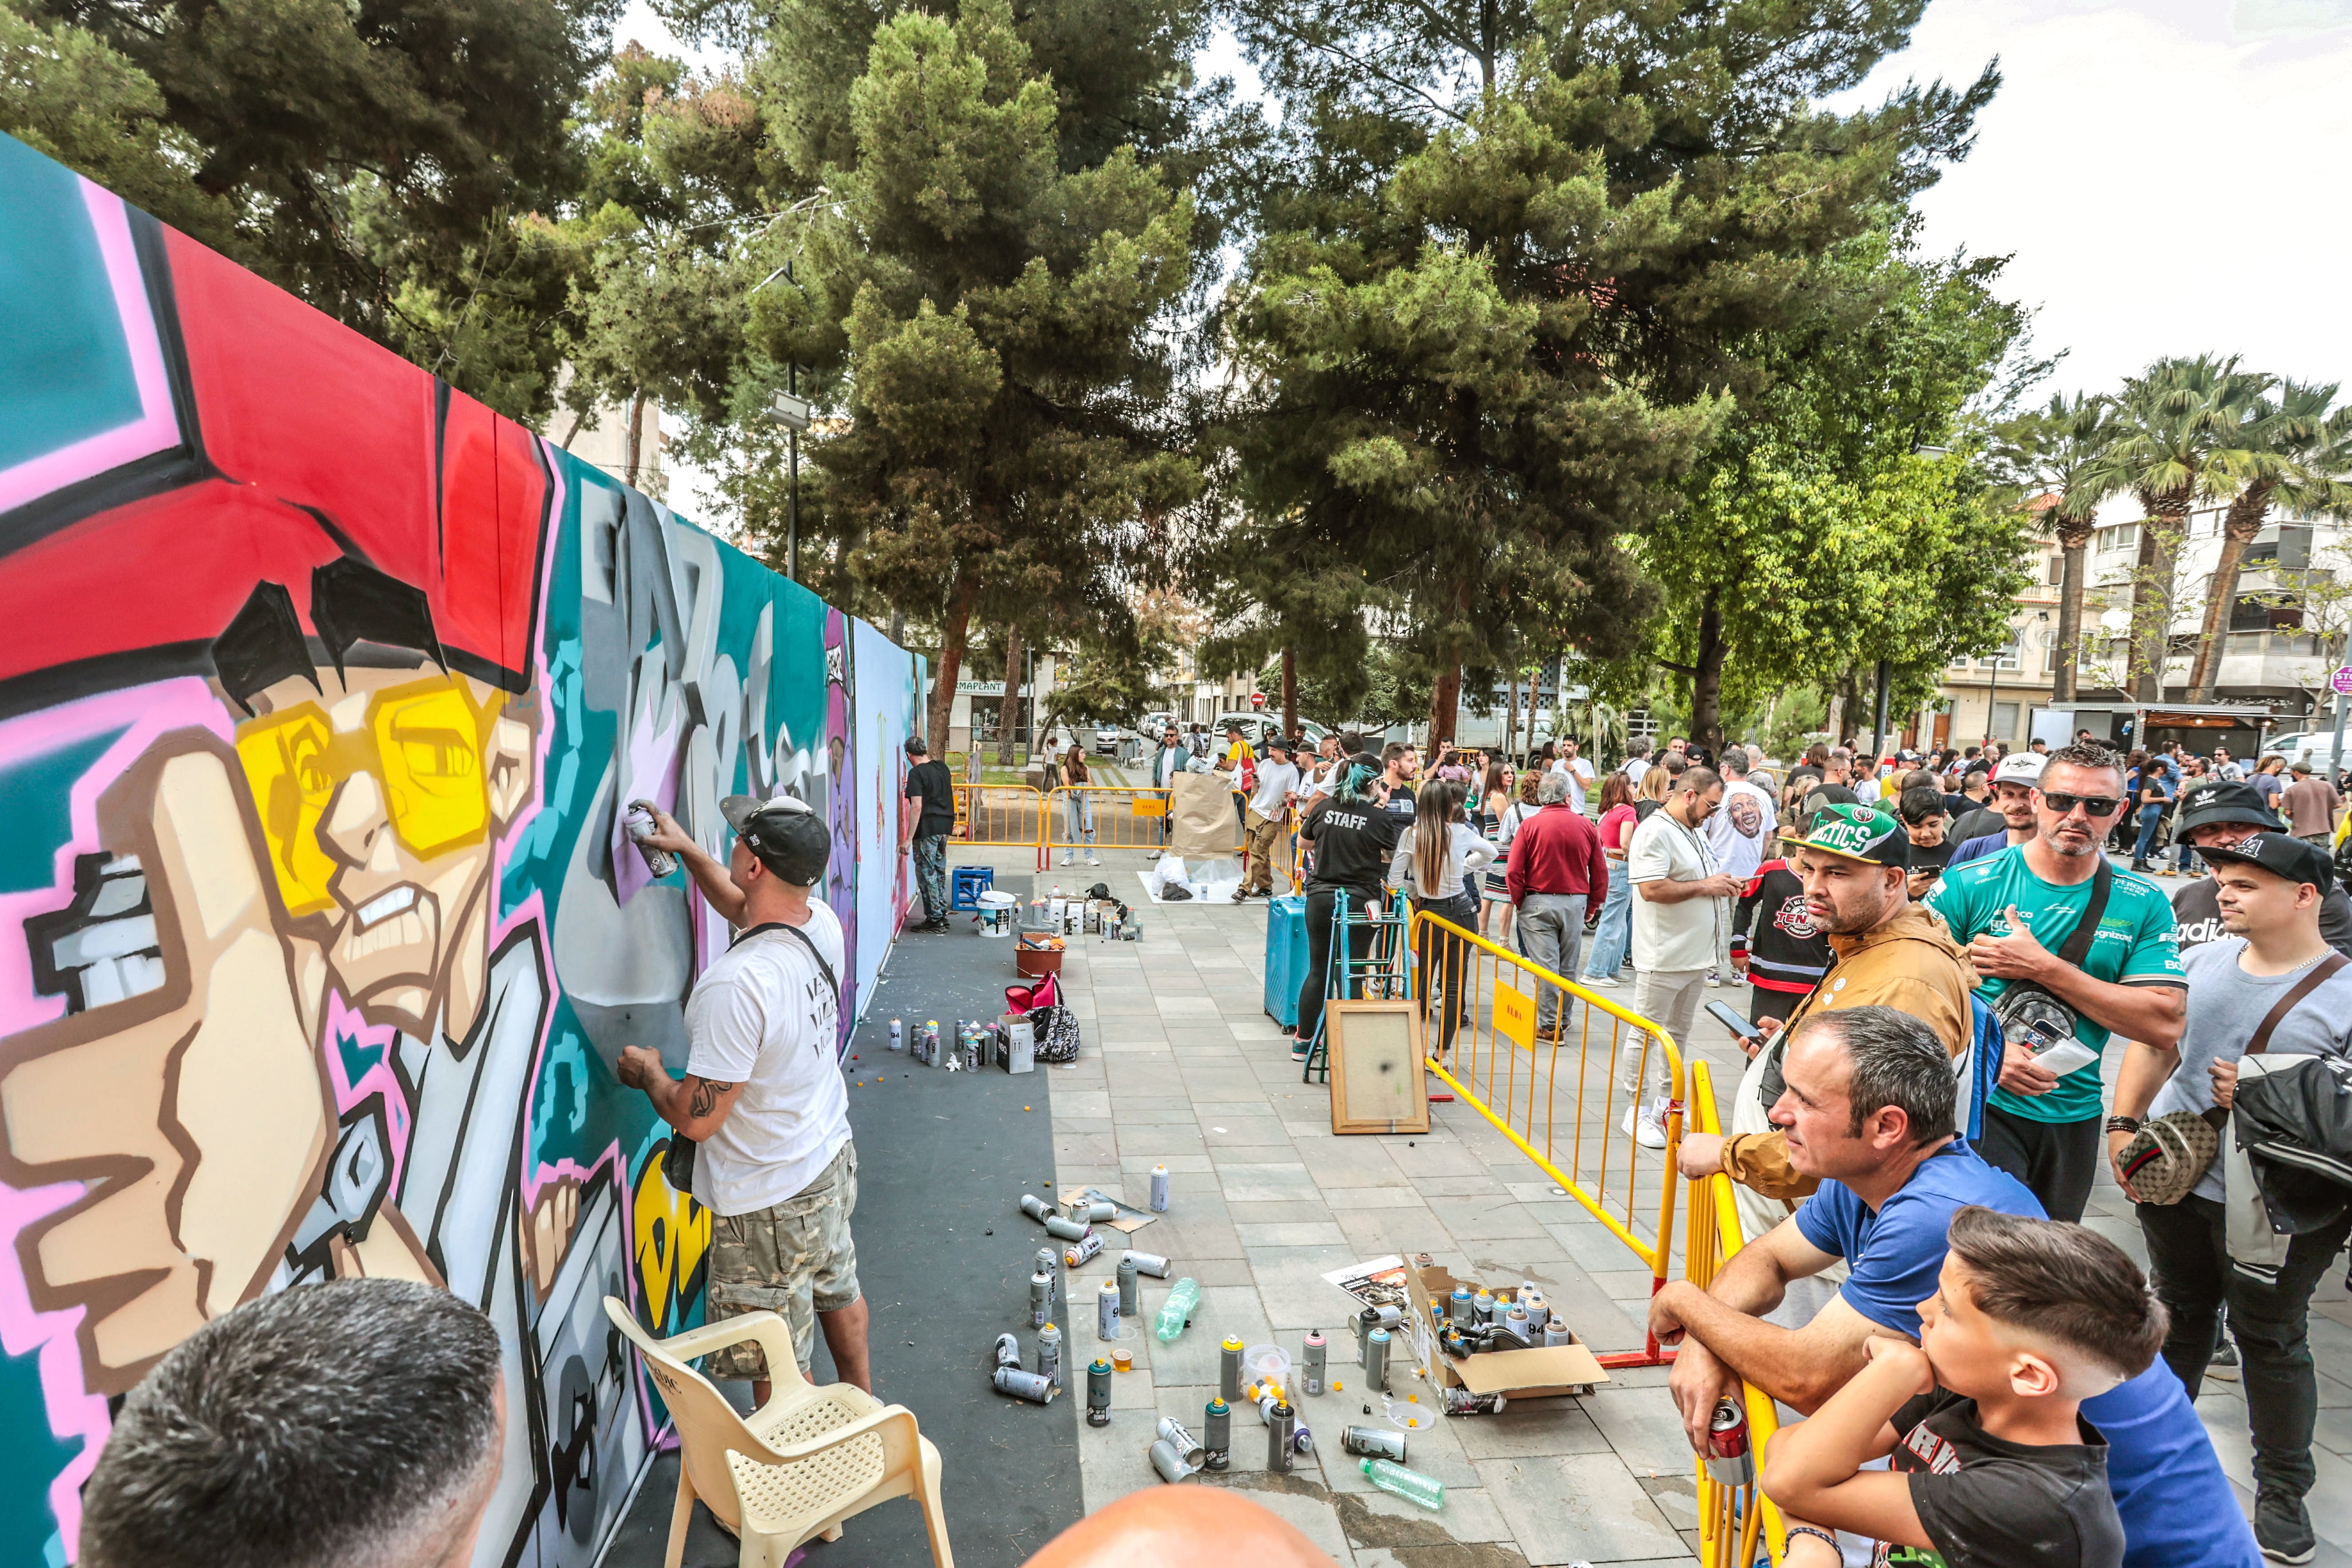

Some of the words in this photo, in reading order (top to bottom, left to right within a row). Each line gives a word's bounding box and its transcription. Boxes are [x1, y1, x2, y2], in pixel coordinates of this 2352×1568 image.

[1324, 810, 1367, 830] STAFF
[1809, 811, 1871, 852] CELTICS
[1975, 874, 2001, 885] crypto.com
[2115, 879, 2150, 893] PERONI
[998, 1041, 1007, 1055] NBQ
[1088, 1240, 1099, 1250] NBQ
[1529, 1323, 1545, 1335] 94
